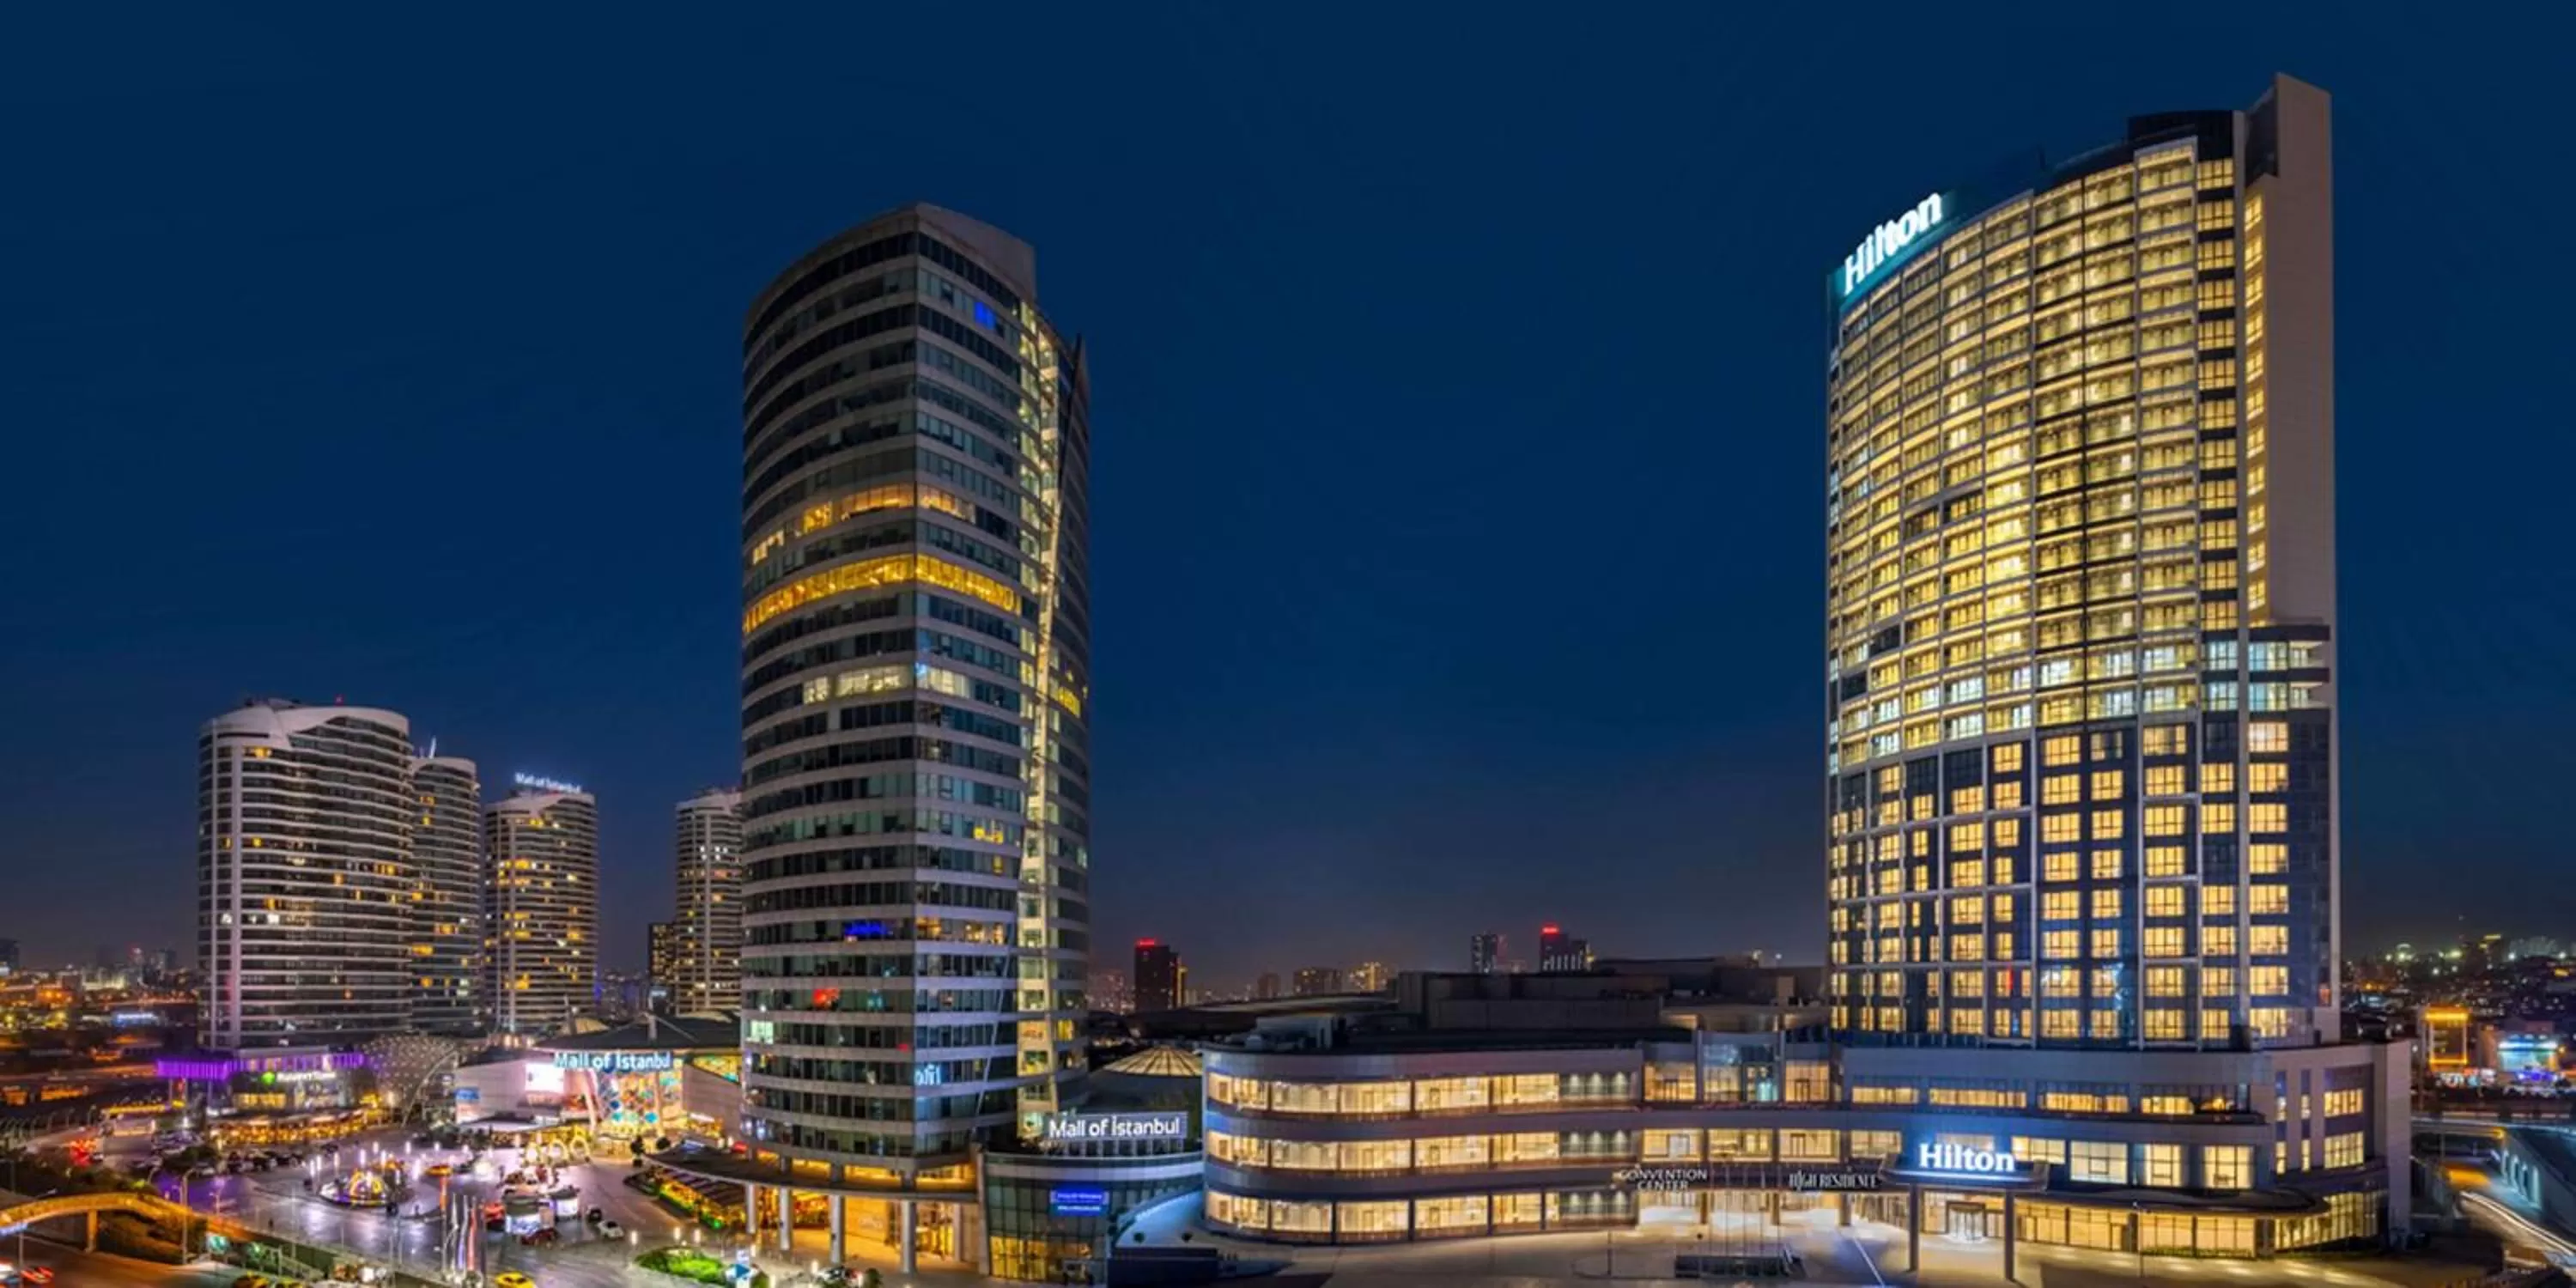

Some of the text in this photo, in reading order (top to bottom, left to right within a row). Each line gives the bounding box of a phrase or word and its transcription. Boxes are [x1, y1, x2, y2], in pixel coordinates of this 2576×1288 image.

[1844, 192, 1942, 296] Hilton
[554, 1052, 589, 1067] Mall
[592, 1052, 614, 1069] of
[1048, 1119, 1085, 1138] Mall
[1089, 1119, 1109, 1136] of
[1919, 1143, 2015, 1172] Hilton
